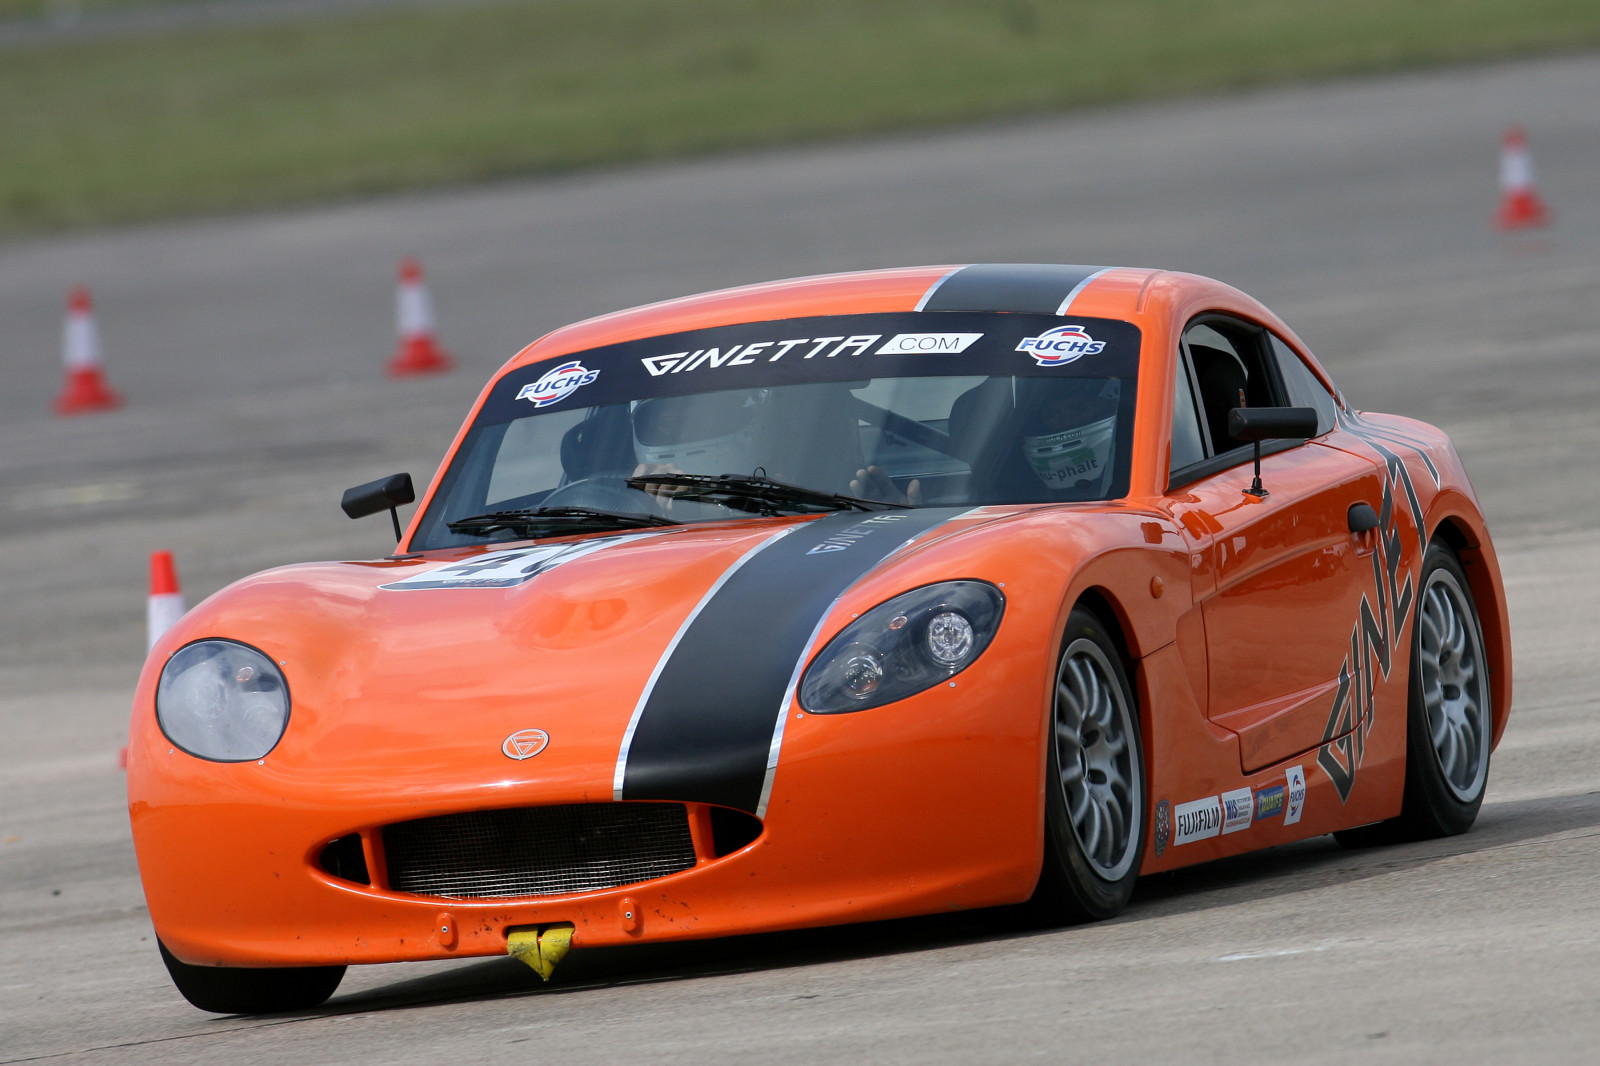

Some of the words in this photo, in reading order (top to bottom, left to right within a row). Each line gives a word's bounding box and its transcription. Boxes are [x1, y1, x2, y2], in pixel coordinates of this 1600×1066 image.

[641, 334, 882, 377] GINETTA
[1018, 339, 1103, 354] FUCHS
[520, 369, 597, 398] FUCHS
[1289, 788, 1305, 804] FUCHS
[1177, 806, 1220, 837] FUJIFILM
